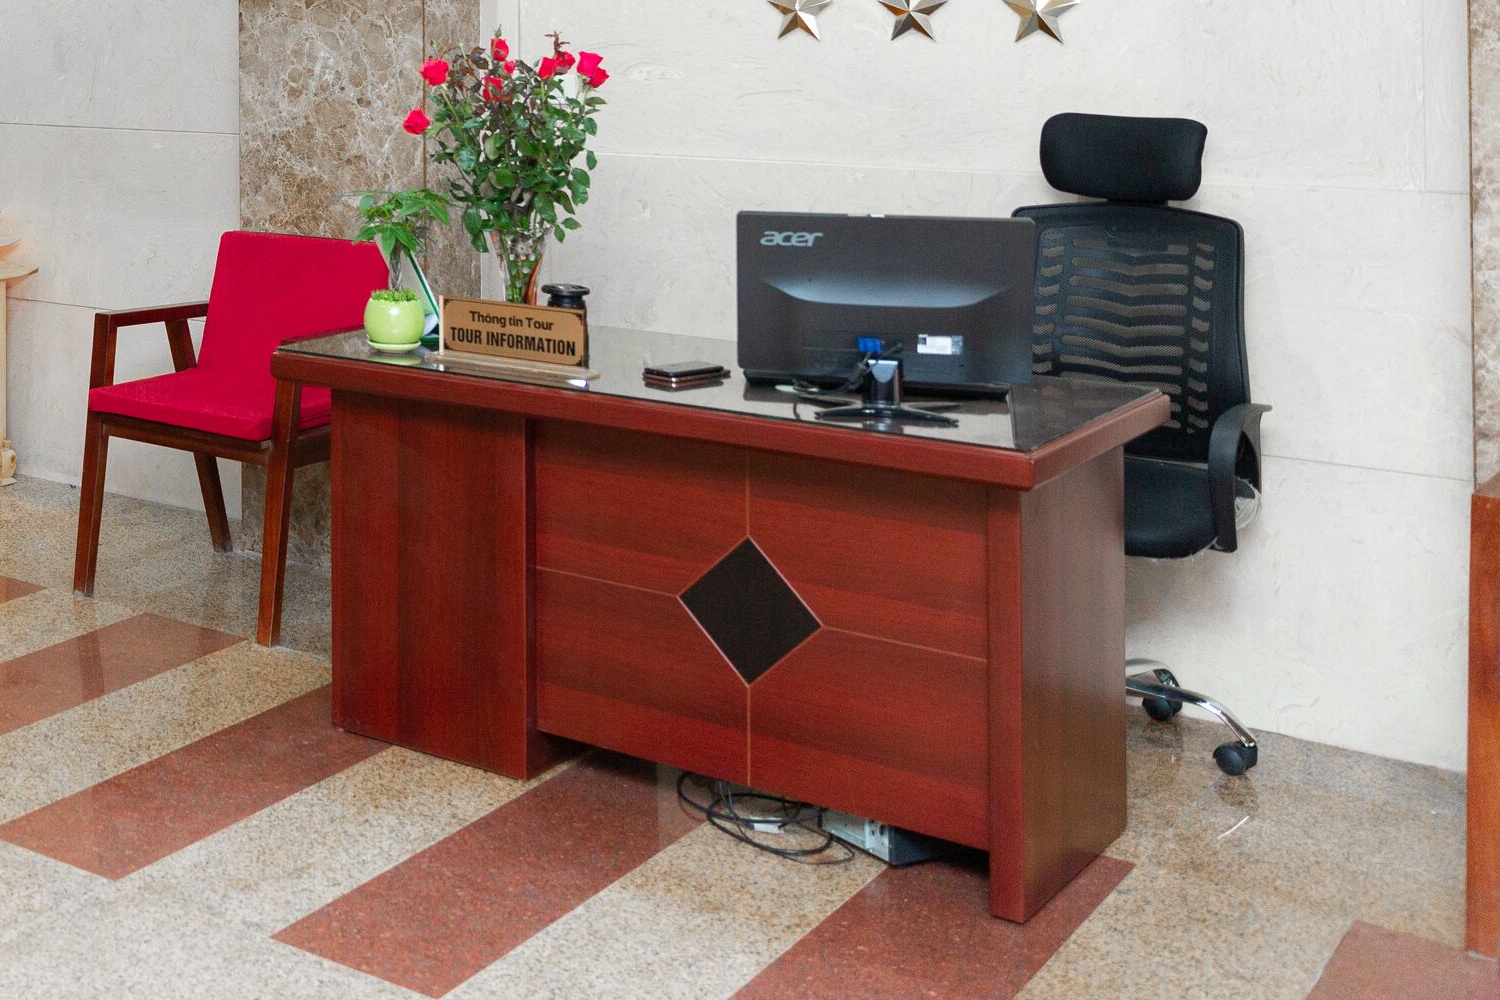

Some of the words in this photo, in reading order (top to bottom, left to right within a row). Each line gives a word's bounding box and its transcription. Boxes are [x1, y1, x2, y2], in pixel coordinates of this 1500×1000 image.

[760, 231, 824, 247] acer
[508, 315, 523, 327] tin
[525, 317, 555, 331] Tour
[450, 327, 482, 344] TOUR
[486, 331, 576, 356] INFORMATION
